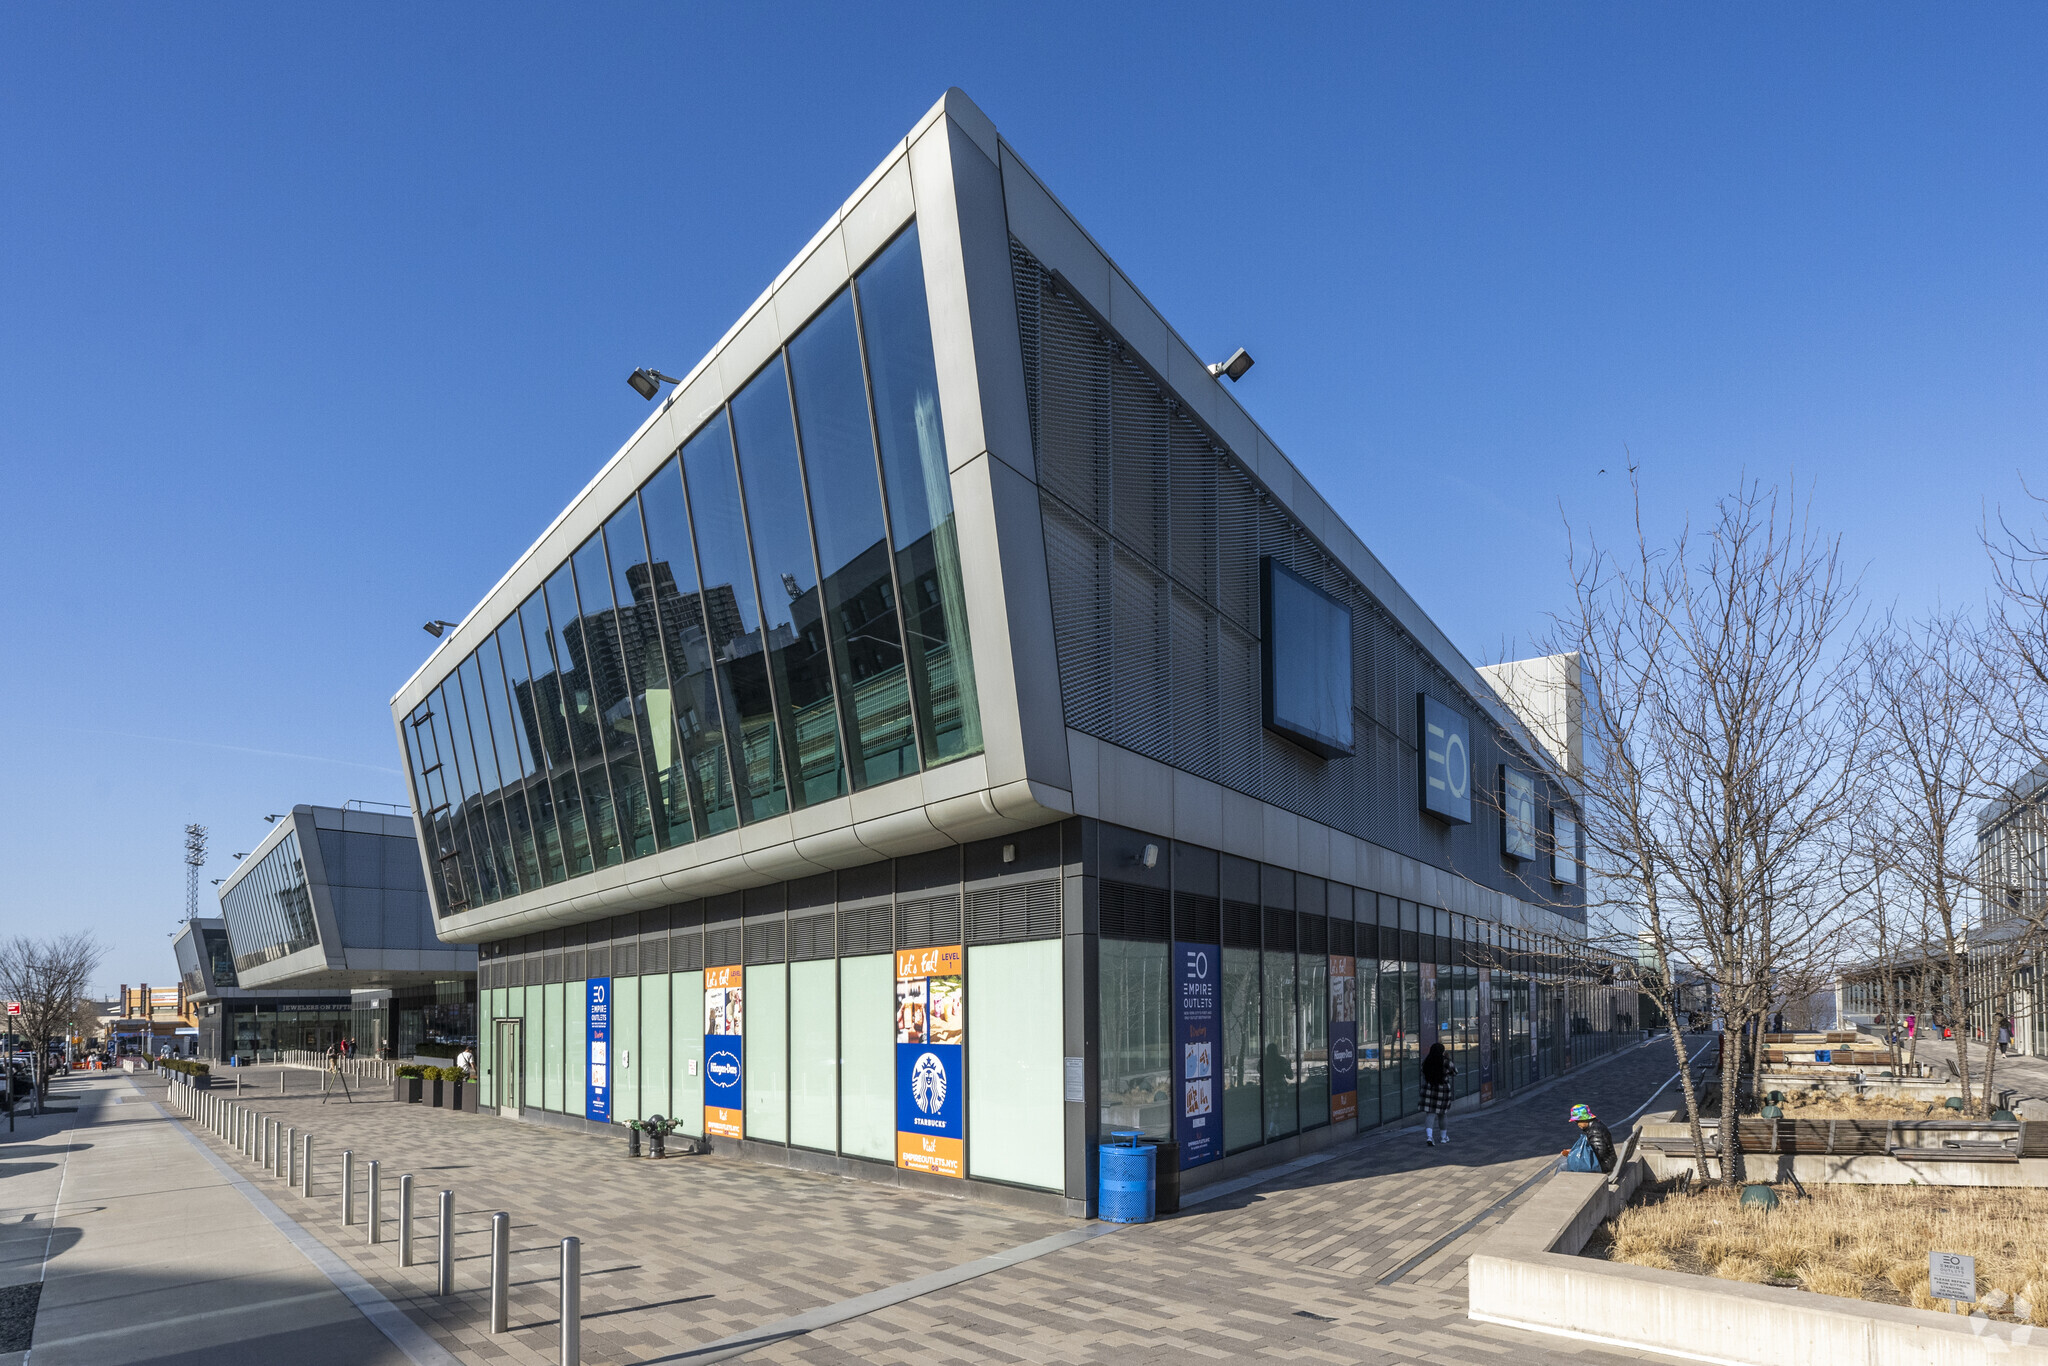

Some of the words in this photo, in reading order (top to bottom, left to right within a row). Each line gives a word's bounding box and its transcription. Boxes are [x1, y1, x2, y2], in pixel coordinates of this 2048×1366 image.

[941, 952, 960, 961] LEVEL
[899, 953, 917, 976] Let's
[921, 949, 939, 973] Eat!
[1183, 983, 1212, 995] EMPIRE
[282, 1004, 319, 1012] JEWELERS
[591, 1004, 607, 1013] EMPIRE
[1183, 998, 1213, 1008] OUTLETS
[913, 1117, 946, 1128] STARBUCKS
[922, 1136, 937, 1152] Visit
[902, 1152, 958, 1169] EMPIREOUTLETS.NYC
